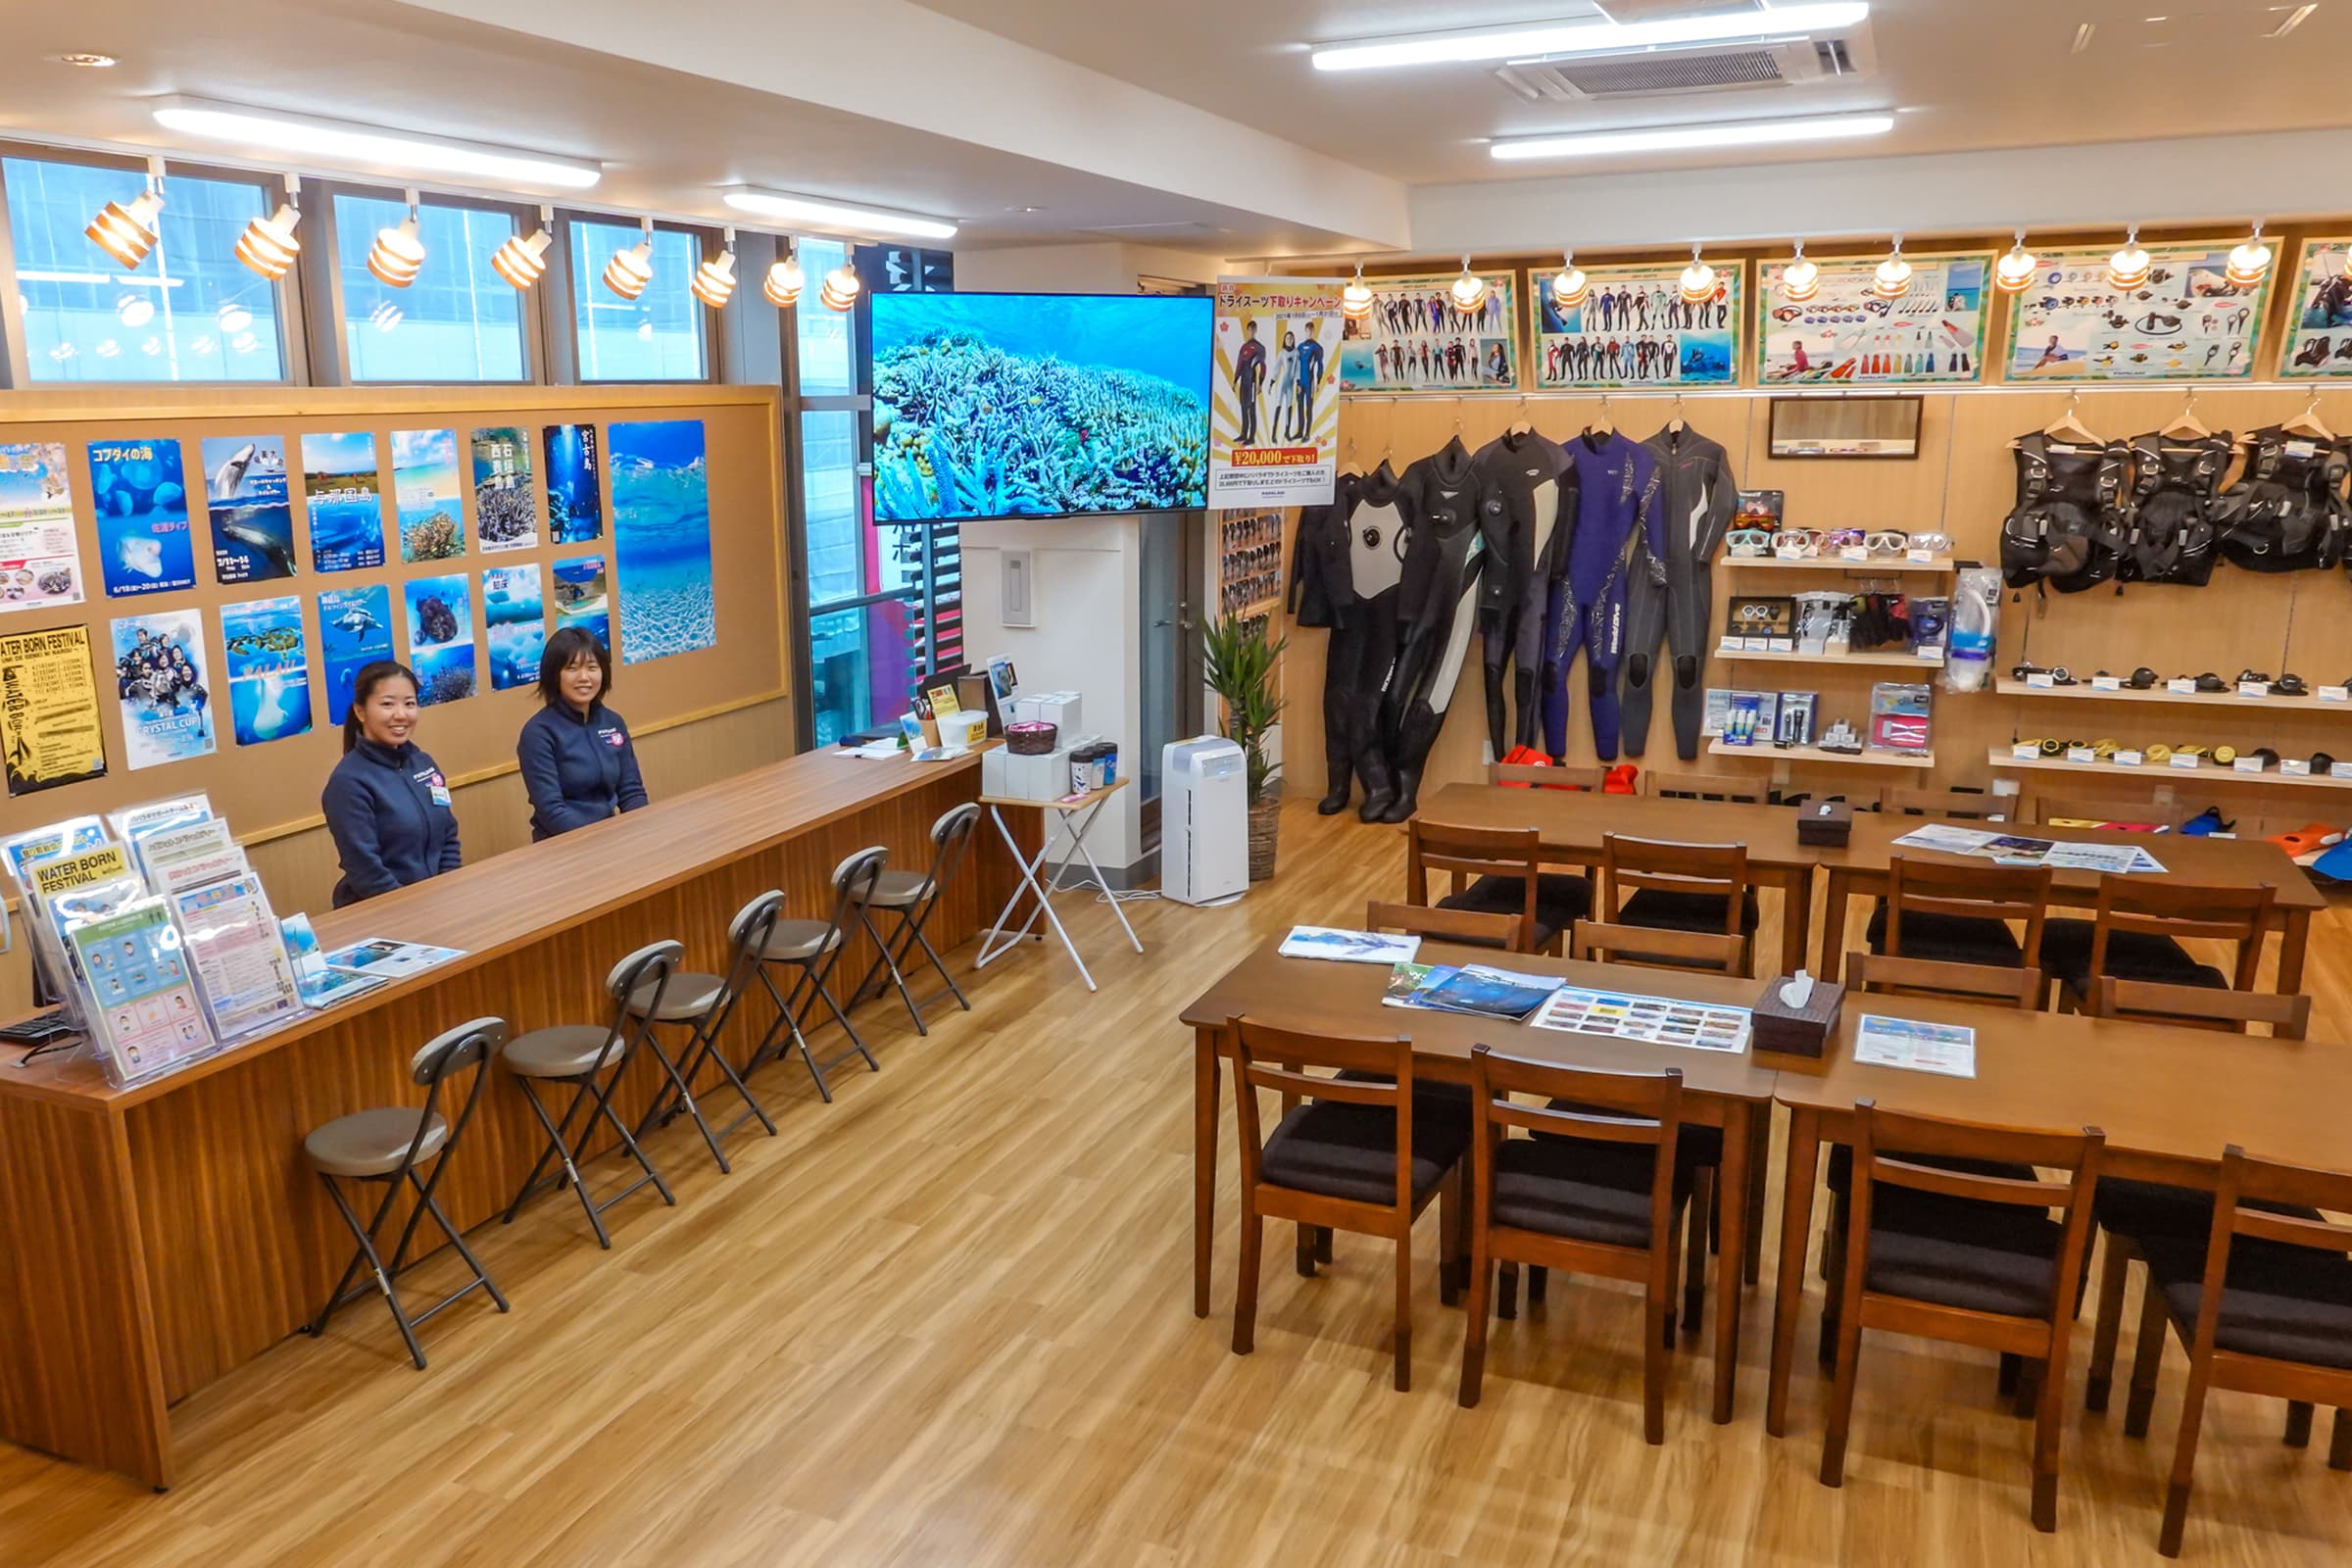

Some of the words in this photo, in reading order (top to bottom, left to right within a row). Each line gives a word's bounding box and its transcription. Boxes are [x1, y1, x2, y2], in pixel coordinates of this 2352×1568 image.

[1219, 294, 1342, 309] ドライスーツ下取りキャンペーン
[24, 635, 46, 655] BORN
[47, 630, 85, 651] FESTIVAL
[179, 716, 198, 728] CUP
[37, 861, 78, 883] WATER
[89, 851, 118, 871] BORN
[42, 870, 97, 894] FESTIVAL
